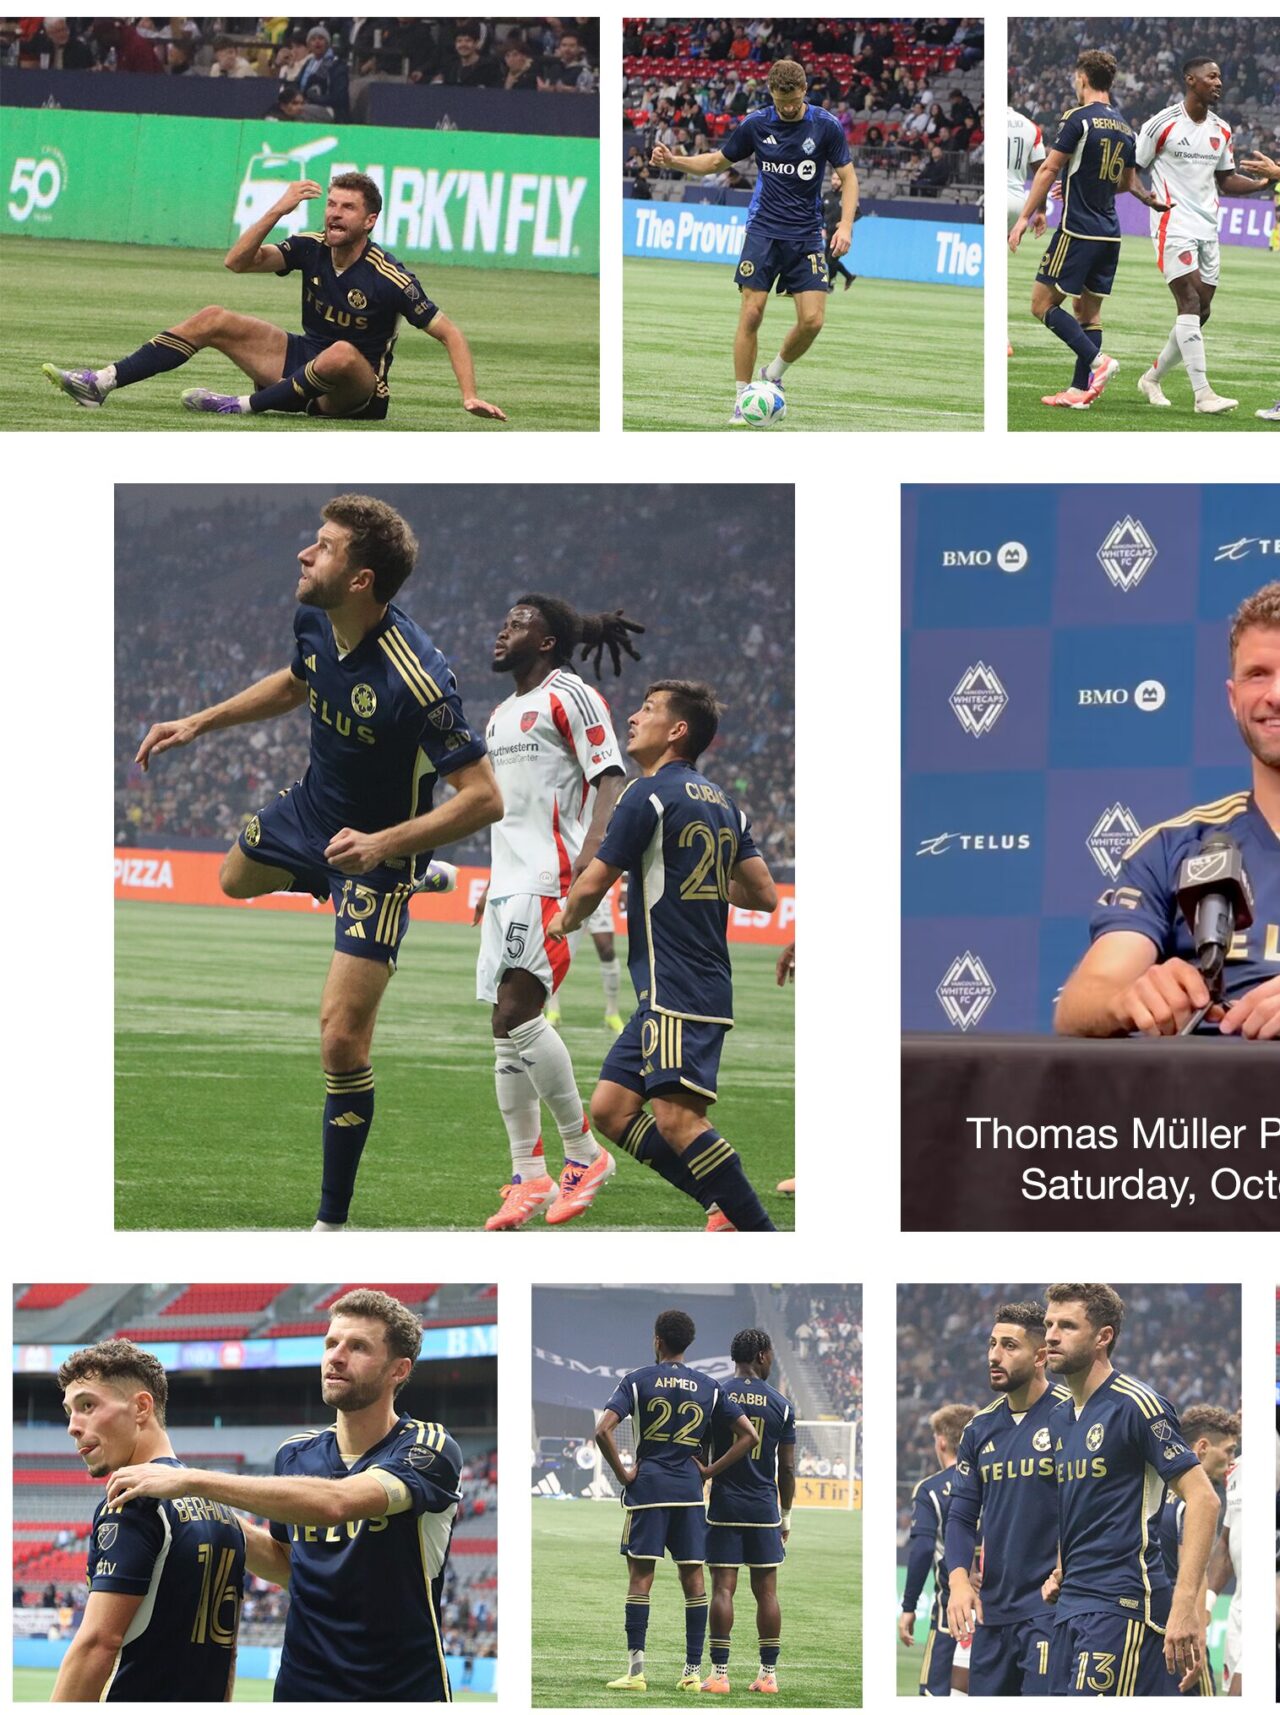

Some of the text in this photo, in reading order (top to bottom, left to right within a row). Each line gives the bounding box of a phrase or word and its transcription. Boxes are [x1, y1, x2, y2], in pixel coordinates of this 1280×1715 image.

[762, 161, 795, 175] BMO
[1099, 138, 1125, 183] 16
[8, 158, 61, 221] 50
[329, 162, 587, 258] ARK'N FLY
[636, 208, 675, 249] The
[807, 253, 829, 275] 13
[936, 231, 981, 276] The
[943, 550, 992, 567] BMO
[1101, 549, 1152, 558] WHITECAPS
[1121, 557, 1132, 566] FC
[953, 695, 1004, 705] WHITECAPS
[973, 704, 984, 713] FC
[1078, 689, 1128, 705] BMO
[307, 681, 376, 745] ELUS
[685, 782, 729, 810] CUBAS
[960, 834, 1031, 850] TELUS
[1090, 837, 1138, 848] WHITECA
[1110, 846, 1122, 855] FC
[679, 820, 738, 903] 20
[337, 880, 377, 920] 13
[506, 921, 529, 960] 5
[940, 986, 992, 996] WHITECAPS
[960, 996, 971, 1005] FC
[655, 1377, 698, 1392] AHMED
[731, 1391, 767, 1407] SABBI
[643, 1397, 704, 1447] 22
[981, 1457, 1054, 1483] TELUS
[1056, 1457, 1108, 1483] ELUS
[191, 1543, 241, 1648] 16
[1076, 1651, 1116, 1690] 13
